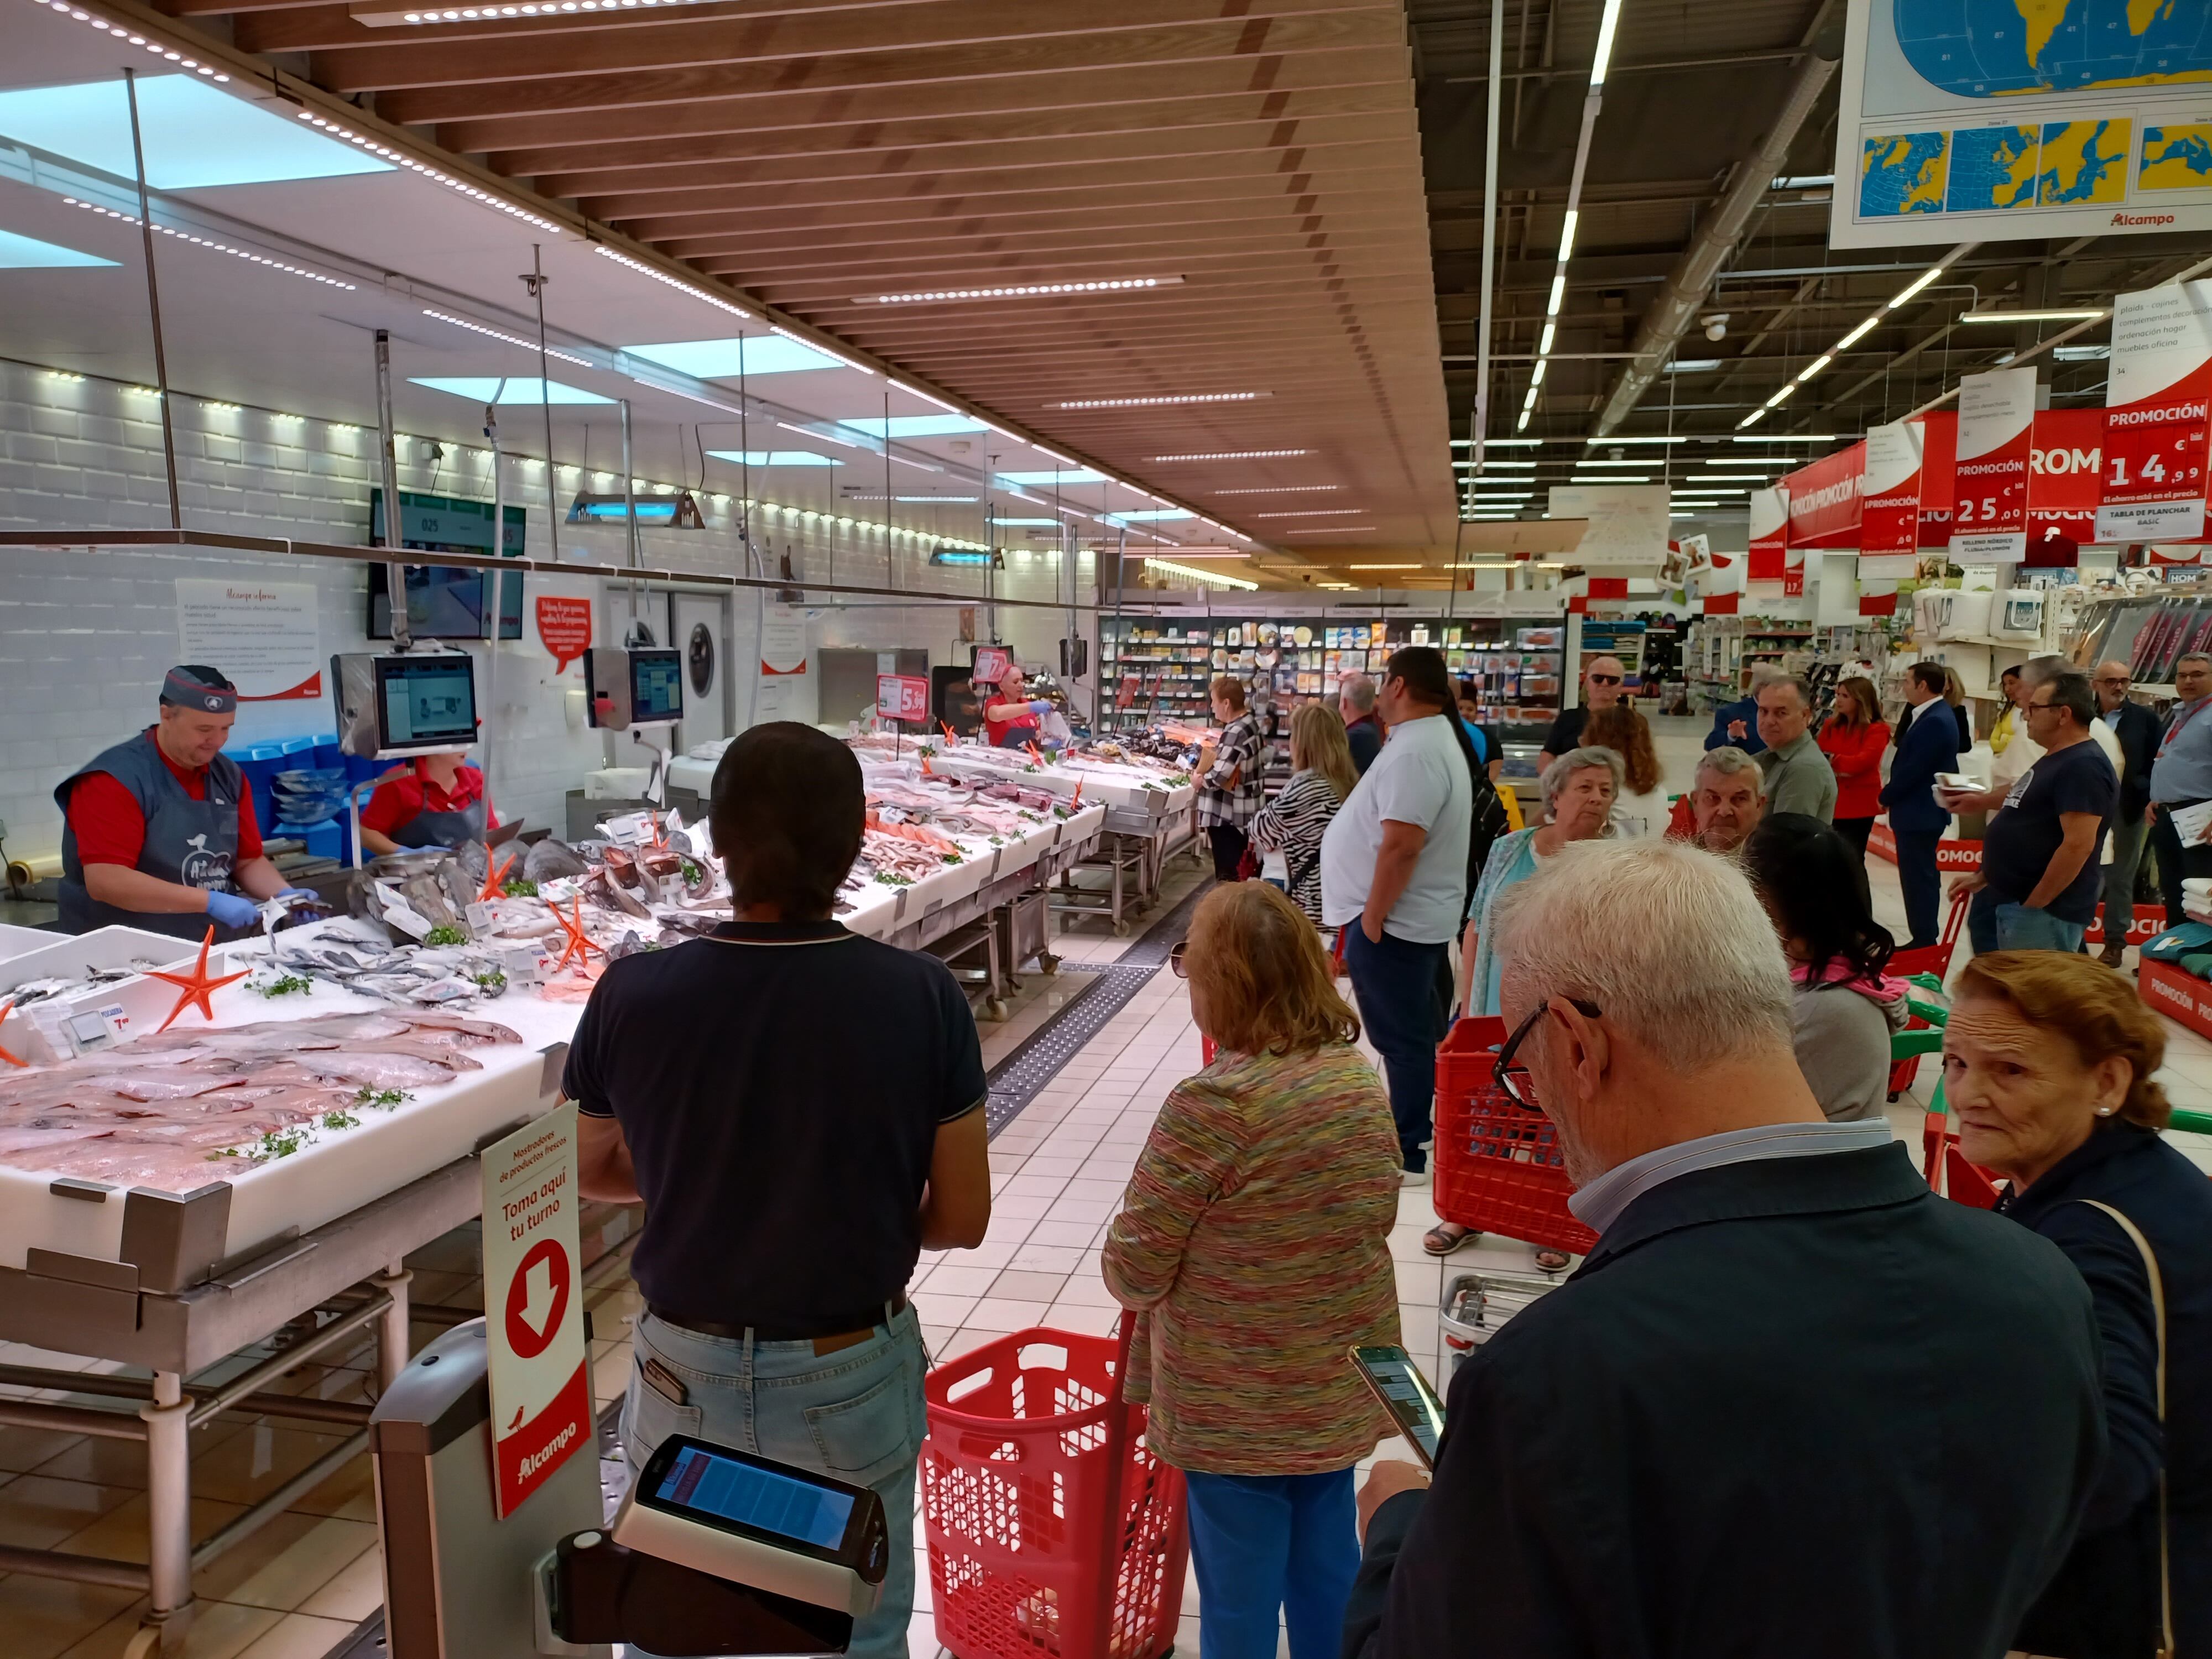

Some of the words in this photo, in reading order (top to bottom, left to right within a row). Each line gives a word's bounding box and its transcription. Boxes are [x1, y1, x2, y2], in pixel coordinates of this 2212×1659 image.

[2110, 213, 2174, 226] Alcampo
[2120, 305, 2143, 315] plaids
[2152, 299, 2179, 309] cojines
[2119, 315, 2171, 327] complementos
[2119, 328, 2161, 341] ordenación
[2163, 325, 2187, 333] hogar
[2117, 343, 2149, 353] muebles
[2151, 339, 2178, 348] oficina
[2109, 403, 2205, 426] PROMOCIÓN
[1957, 460, 2023, 476] PROMOCIÓN
[2111, 494, 2135, 503] ahorro
[2173, 489, 2198, 499] precio
[2147, 507, 2190, 515] PLANCHAR
[422, 518, 439, 532] 025
[2151, 978, 2193, 1011] PROMOCIÓN
[513, 1130, 555, 1161] Mostradores
[499, 1172, 508, 1183] de
[510, 1150, 544, 1180] productos
[545, 1136, 567, 1155] frescos
[502, 1191, 538, 1222] Toma
[540, 1165, 566, 1198] aquí
[510, 1223, 524, 1241] tu
[527, 1199, 560, 1230] turno
[518, 1422, 576, 1485] Alcampo
